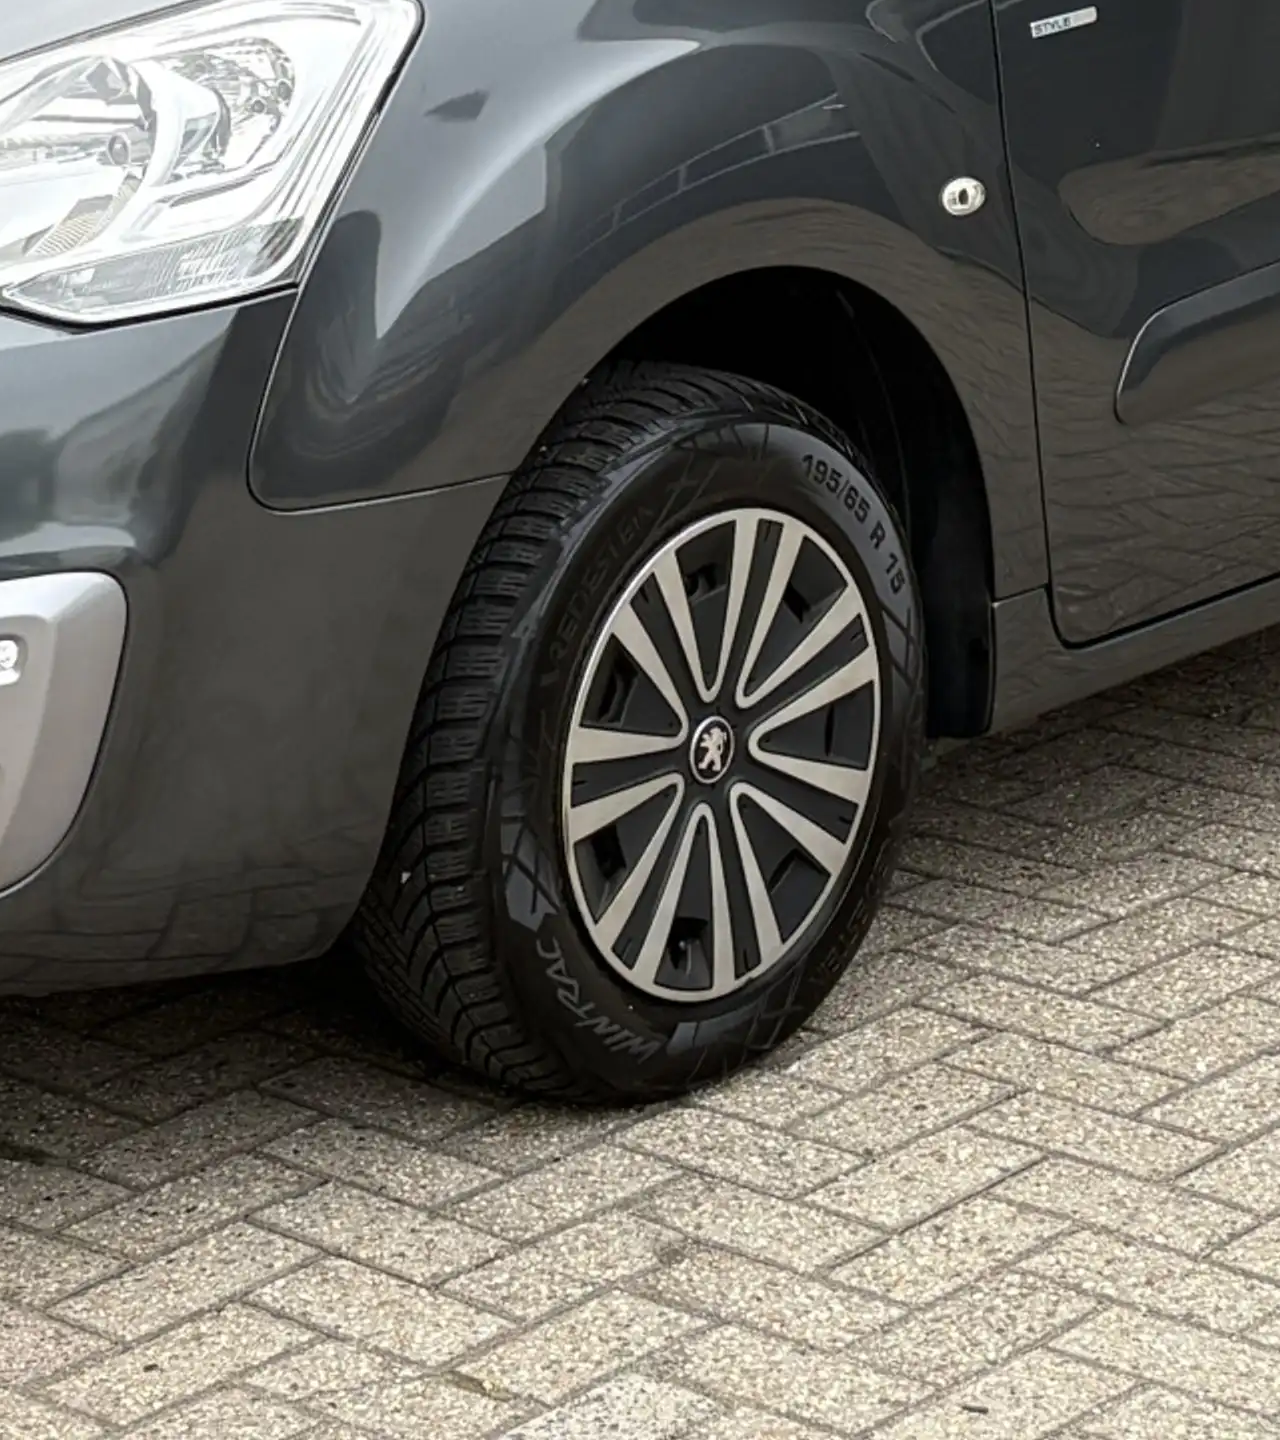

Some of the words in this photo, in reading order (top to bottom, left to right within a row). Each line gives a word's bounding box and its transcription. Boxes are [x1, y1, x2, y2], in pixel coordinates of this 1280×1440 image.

[801, 453, 871, 524] 195/65
[869, 519, 886, 550] R
[885, 551, 906, 595] 15
[535, 935, 663, 1065] WINTRAC
